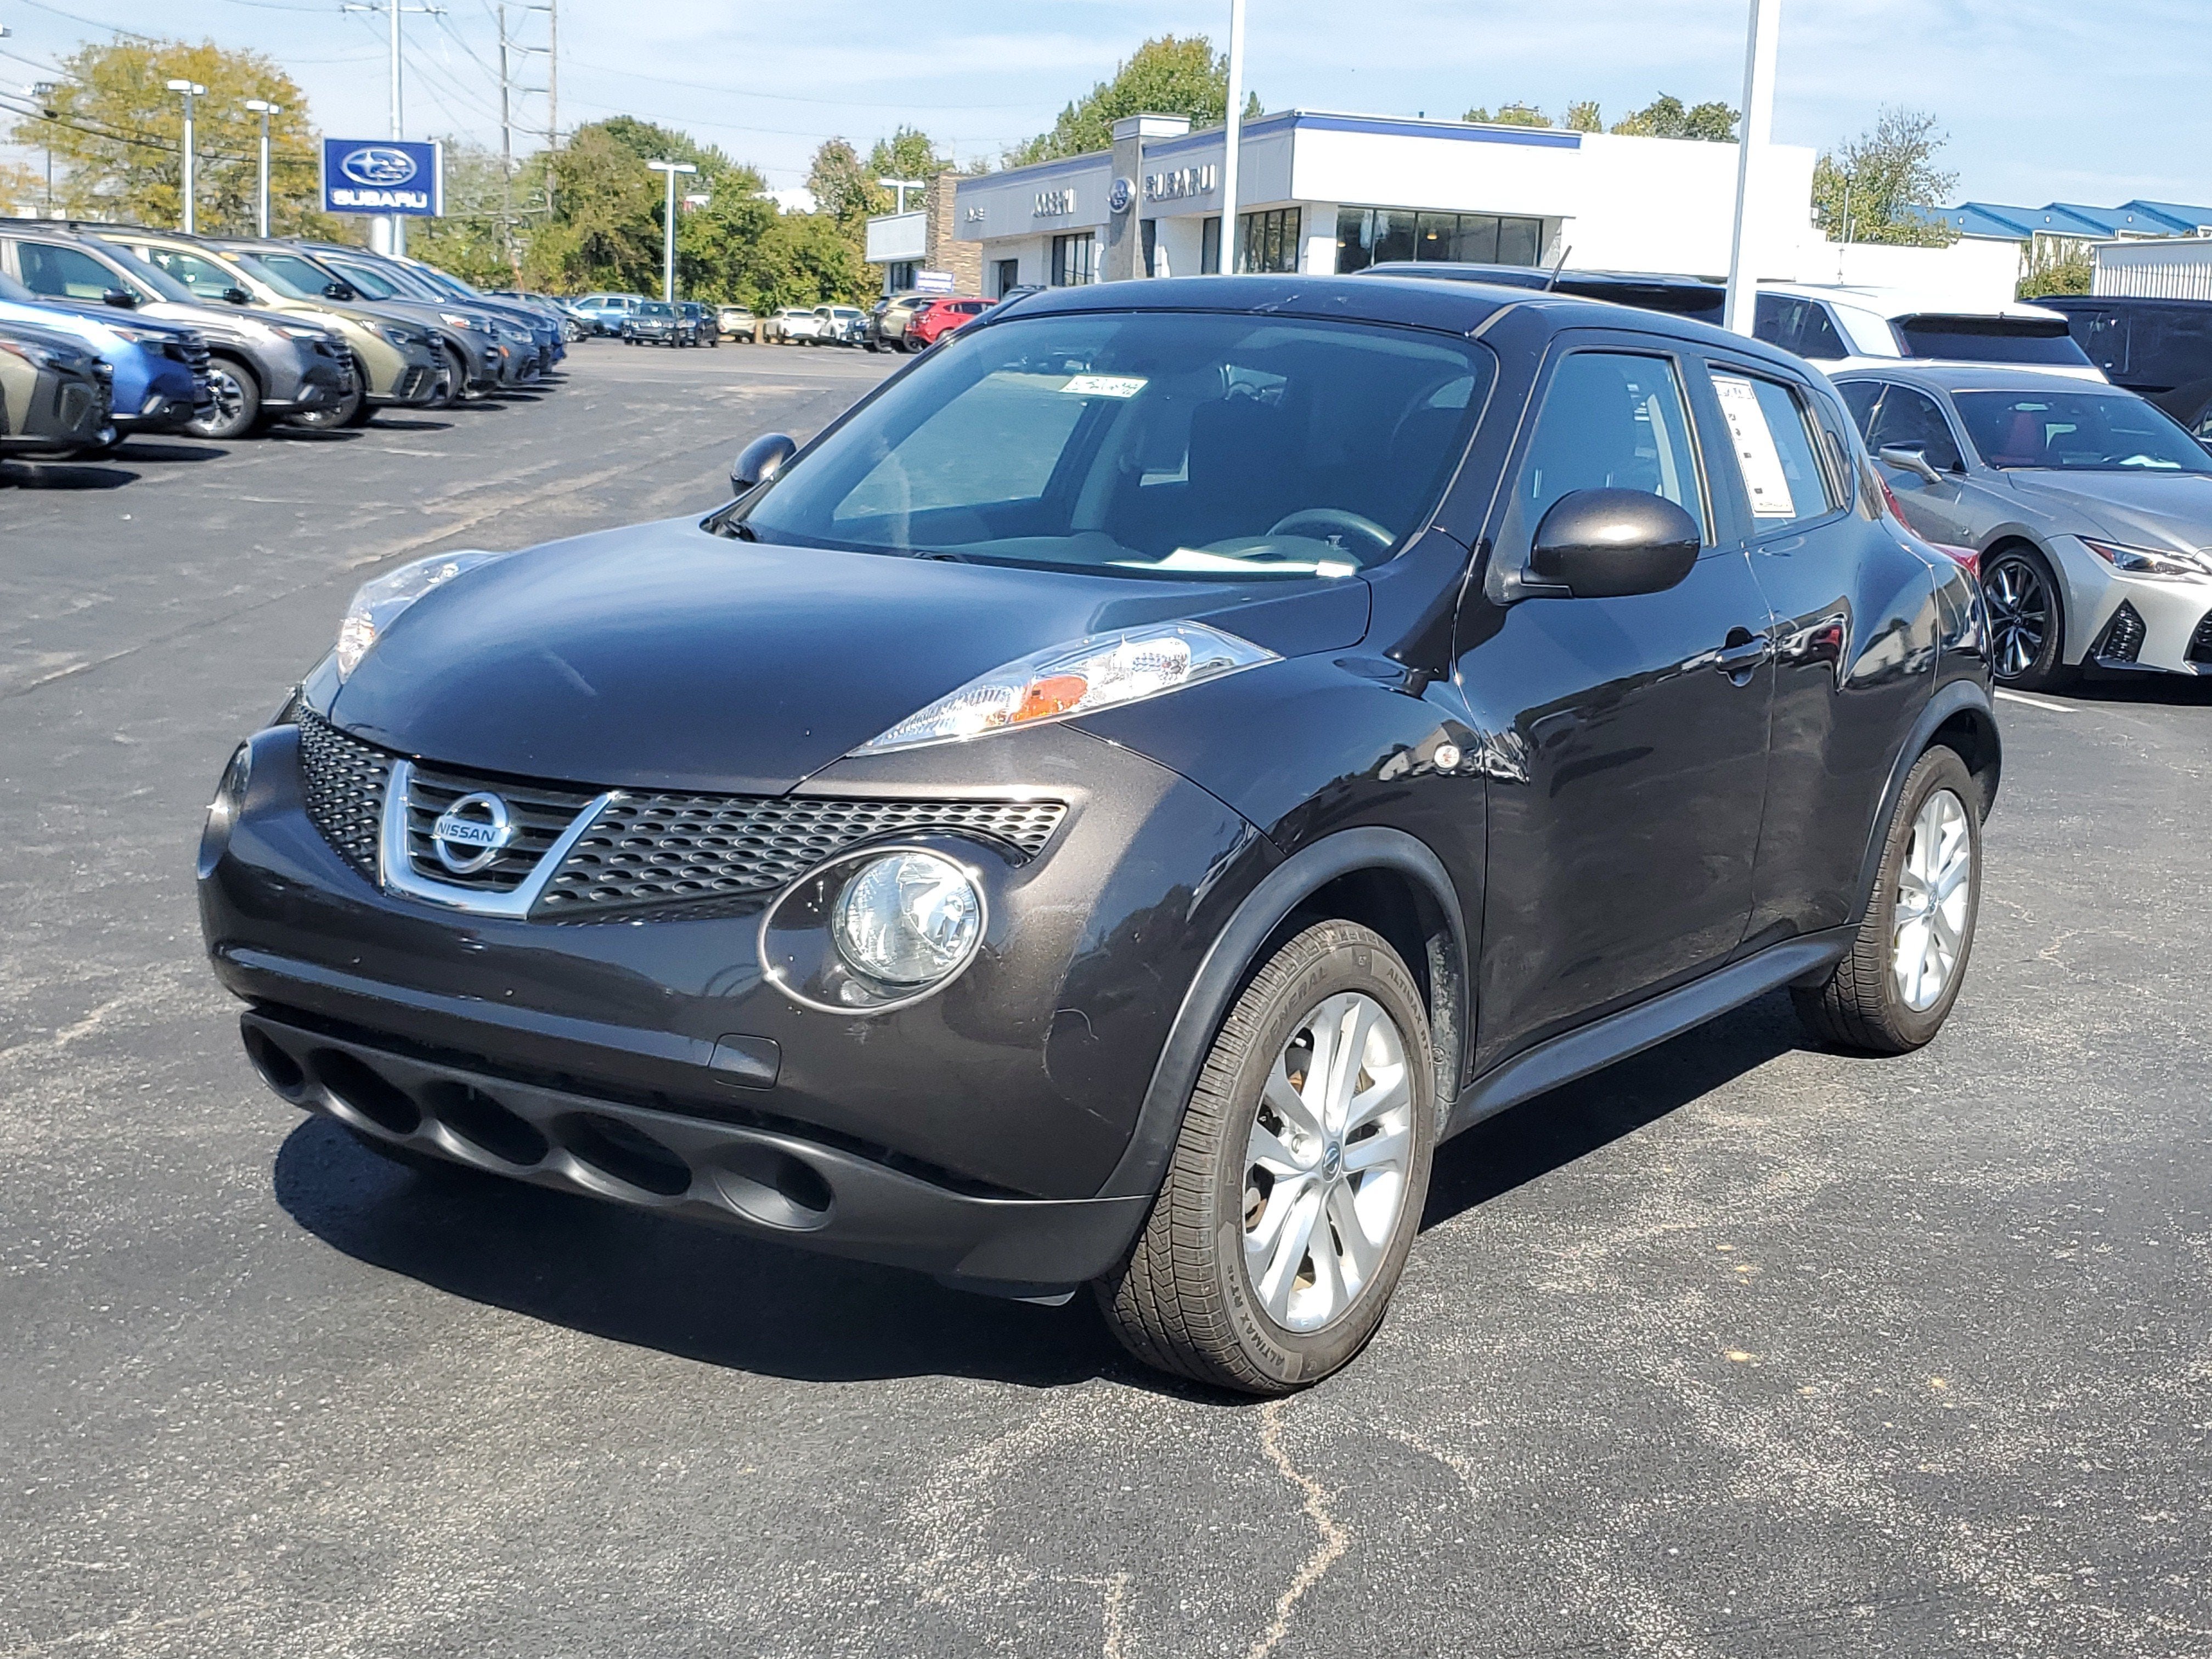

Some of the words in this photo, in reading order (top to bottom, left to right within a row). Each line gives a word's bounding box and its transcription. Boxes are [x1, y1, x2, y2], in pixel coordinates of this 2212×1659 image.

[332, 189, 427, 208] SUBARU
[1143, 164, 1217, 202] SUBARU
[438, 822, 495, 842] NISSAN
[1386, 968, 1423, 1025] ALTIMAX
[1240, 1312, 1285, 1366] ALTIMAX
